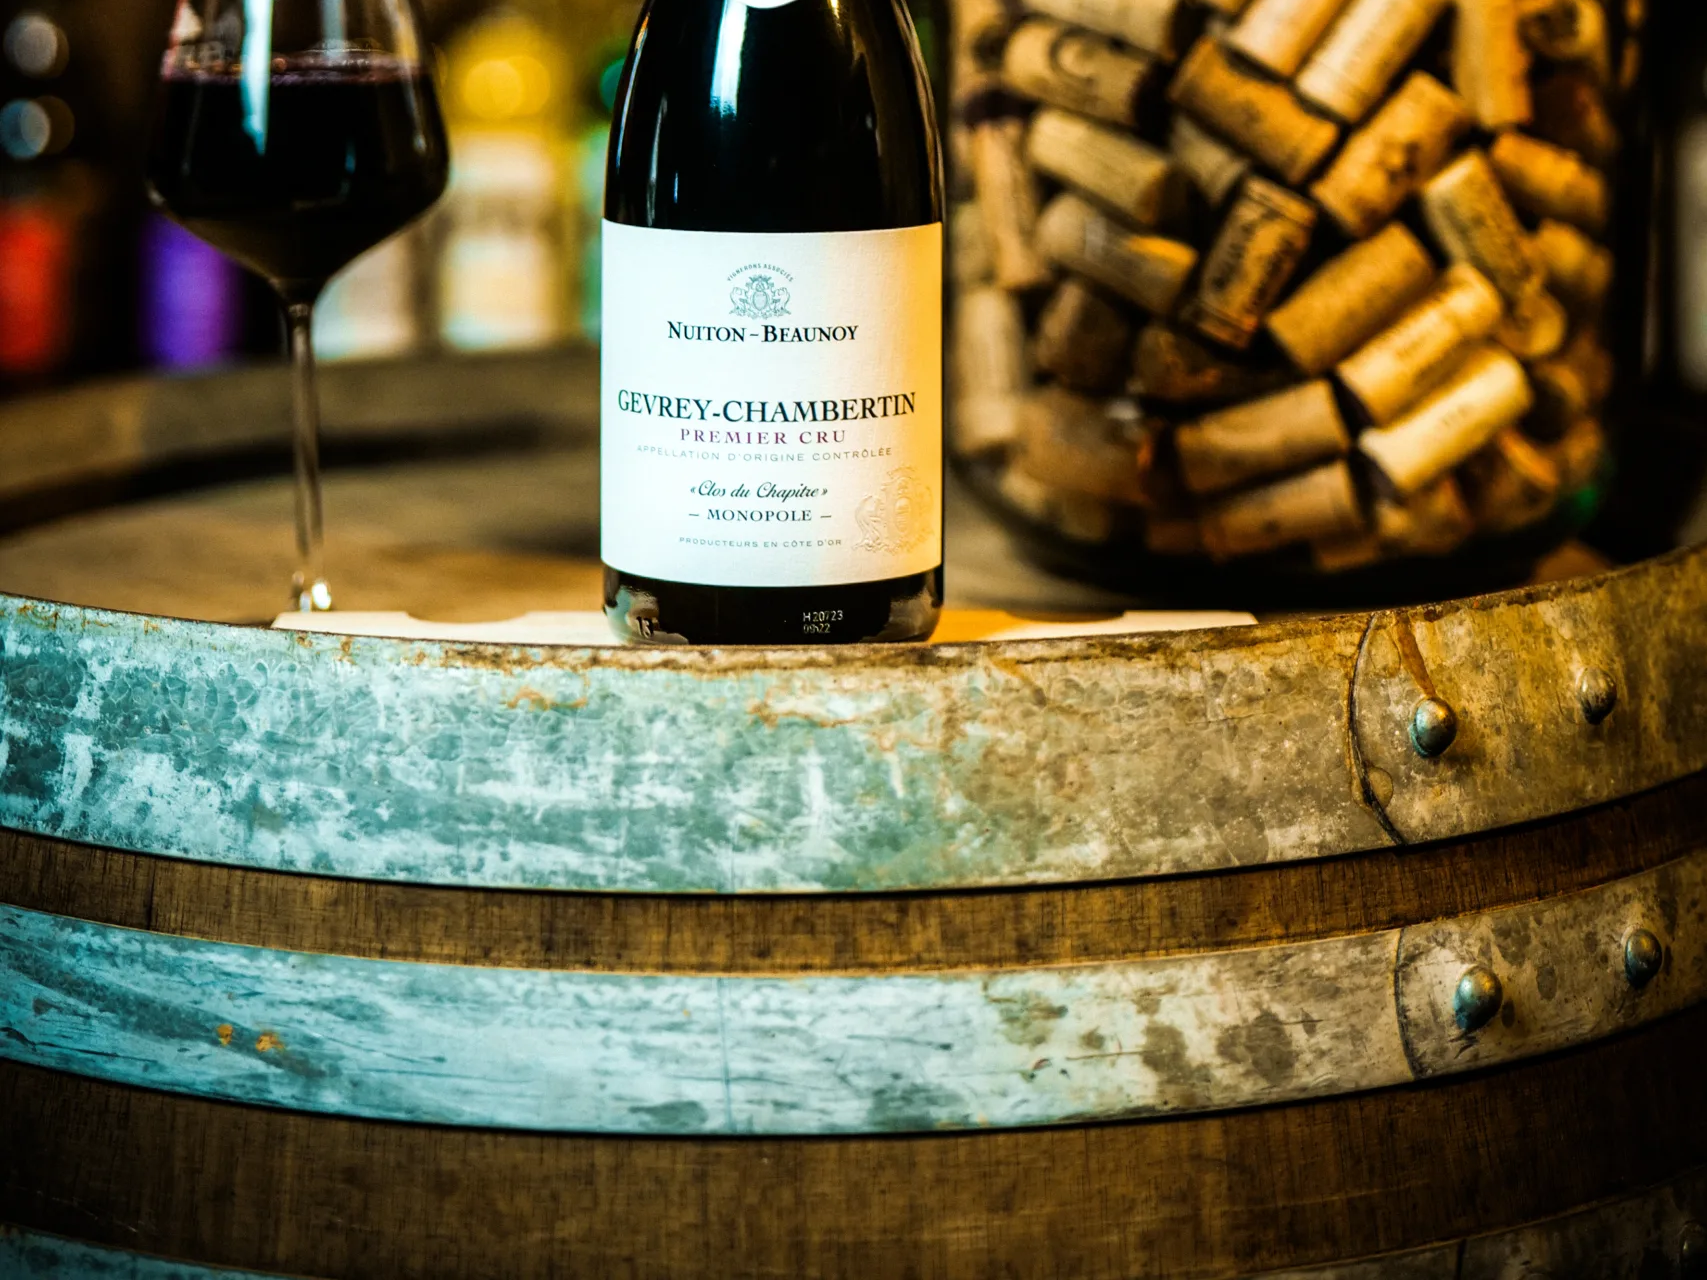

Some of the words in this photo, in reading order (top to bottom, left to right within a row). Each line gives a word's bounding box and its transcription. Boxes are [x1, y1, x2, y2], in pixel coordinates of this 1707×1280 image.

[618, 389, 916, 423] GEVREY-CHAMBERTIN
[680, 428, 788, 445] PREMIER
[799, 430, 847, 444] CRU
[636, 445, 720, 461] APPELLATION
[728, 453, 805, 462] D'ORIGINE
[812, 447, 893, 461] CONTRÔLÉE
[730, 482, 751, 498] du
[707, 509, 812, 522] MONOPOLE
[679, 537, 758, 548] PRODUCTEURS
[783, 538, 812, 548] CÔTE
[817, 538, 842, 547] D'OR
